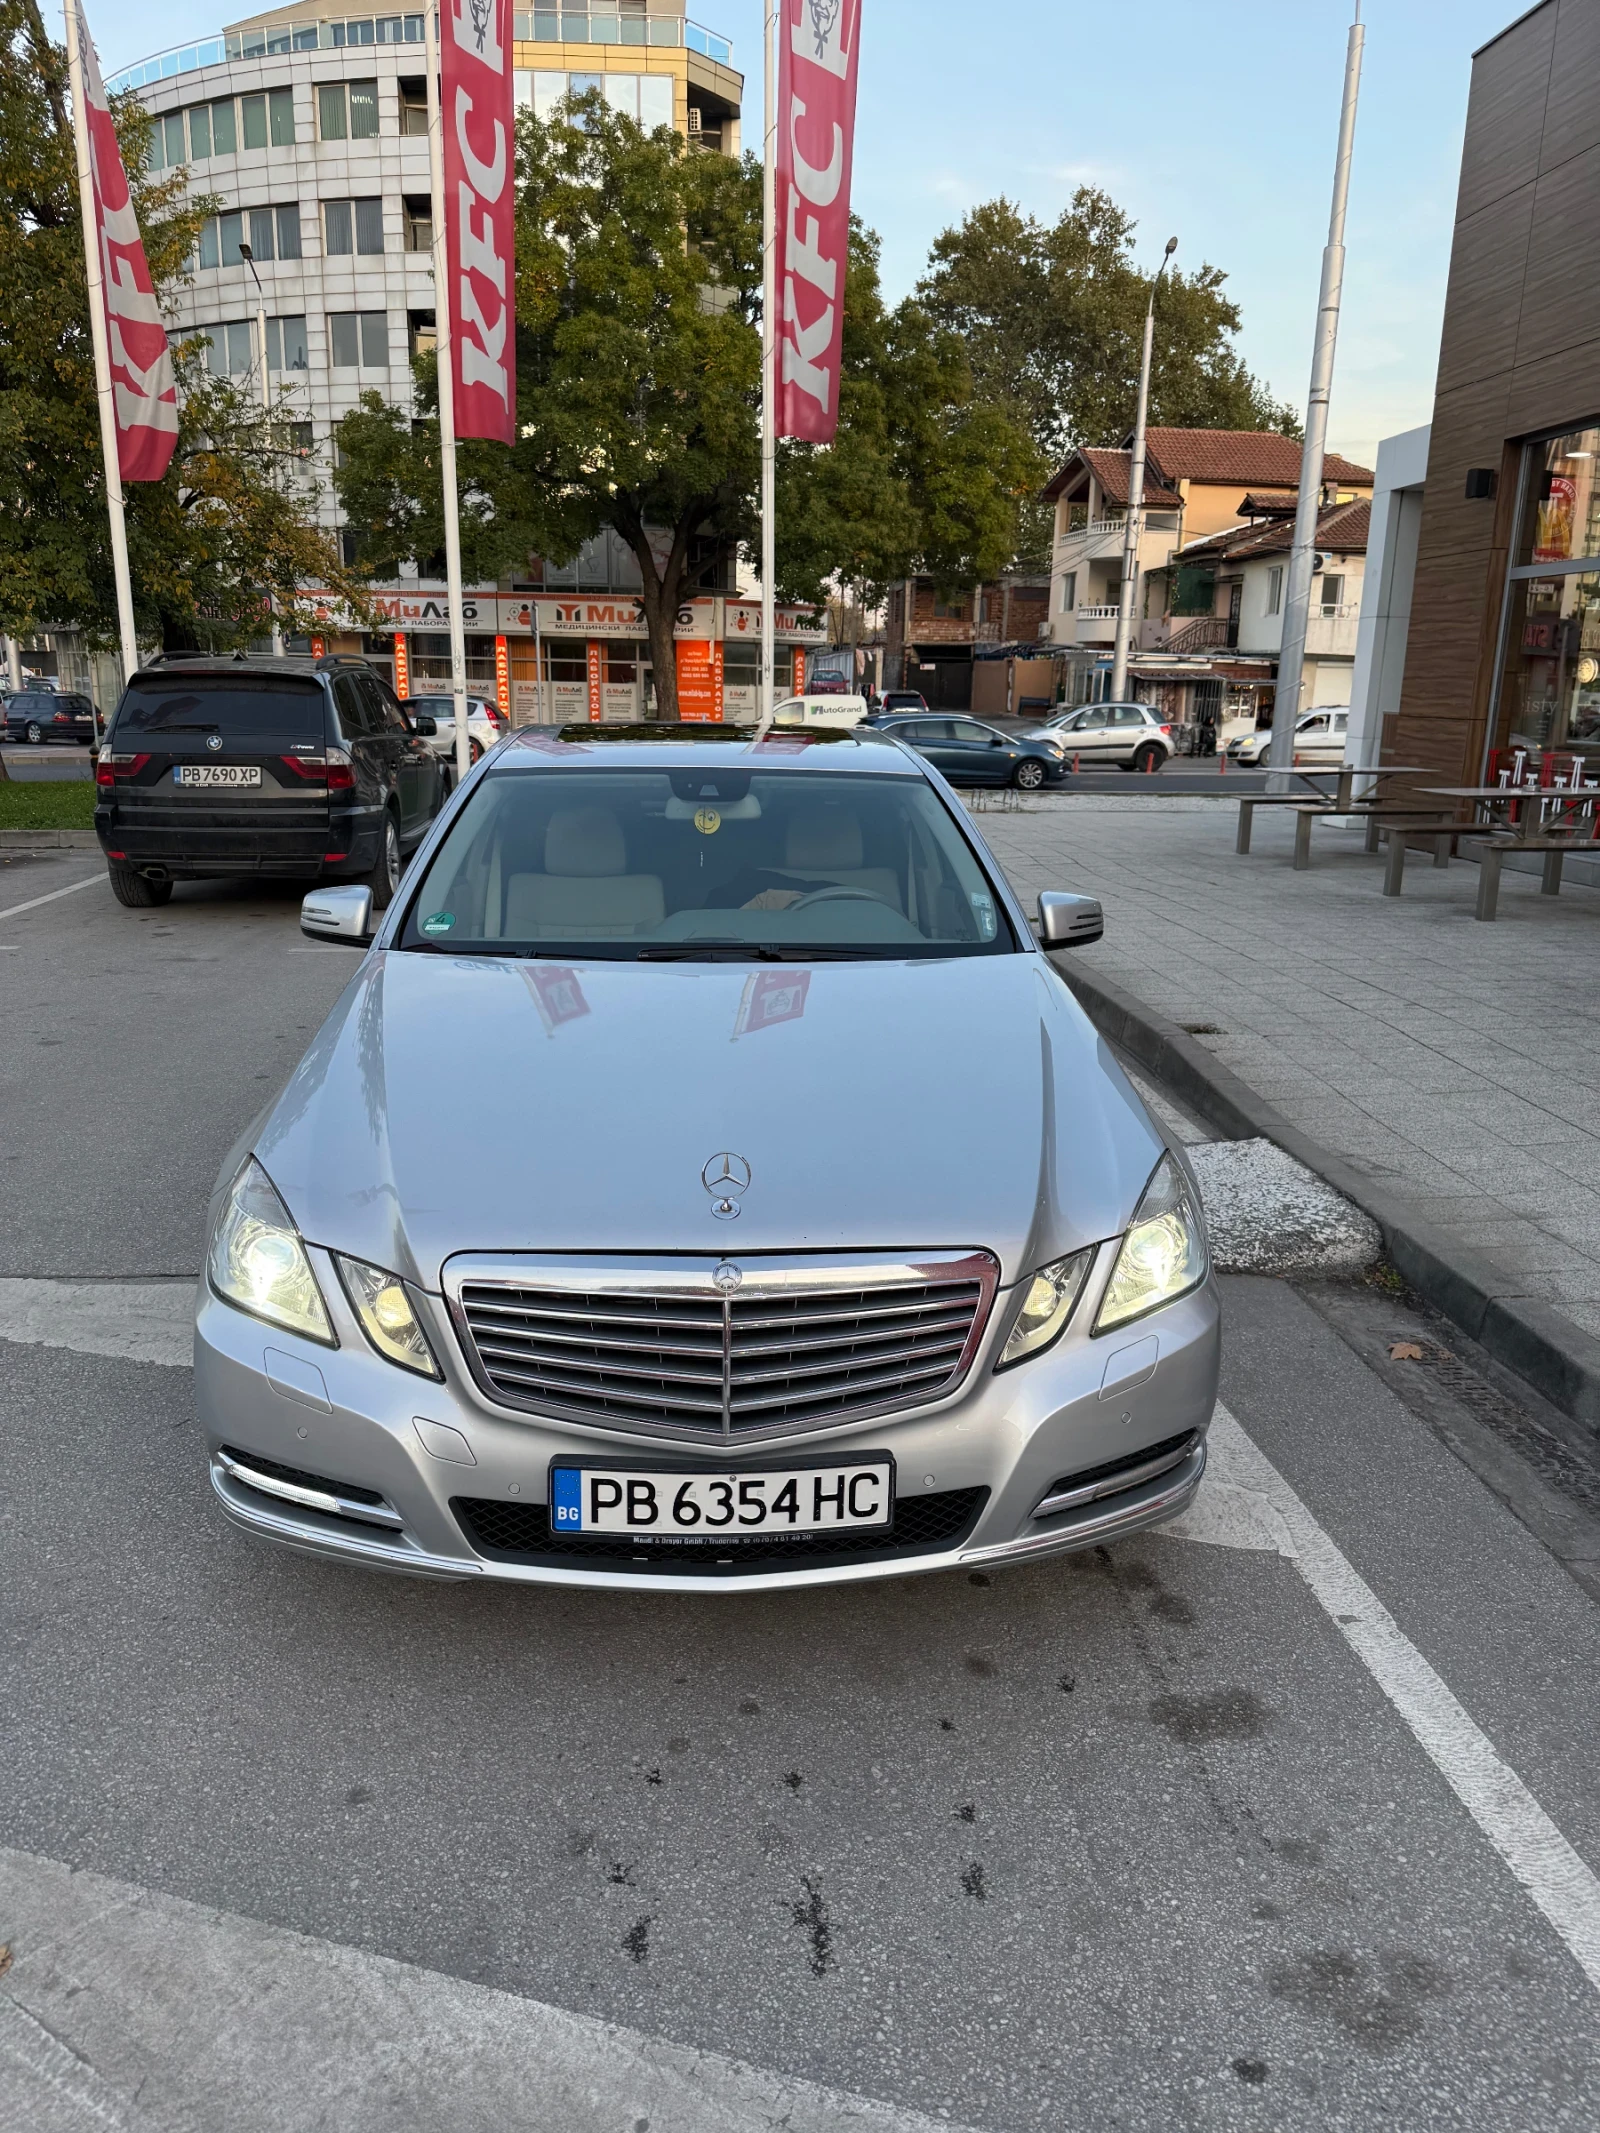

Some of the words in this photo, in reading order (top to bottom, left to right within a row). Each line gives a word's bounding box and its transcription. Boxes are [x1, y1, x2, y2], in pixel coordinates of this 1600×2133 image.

[456, 85, 509, 416] KFC
[782, 91, 843, 415] KFC
[811, 705, 862, 715] AutoGrand
[182, 768, 200, 781] PB
[203, 768, 237, 781] 7690
[240, 768, 259, 782] XP
[557, 1506, 579, 1521] BG
[590, 1477, 659, 1525] PB
[671, 1478, 800, 1527] 6354
[812, 1472, 880, 1522] HC
